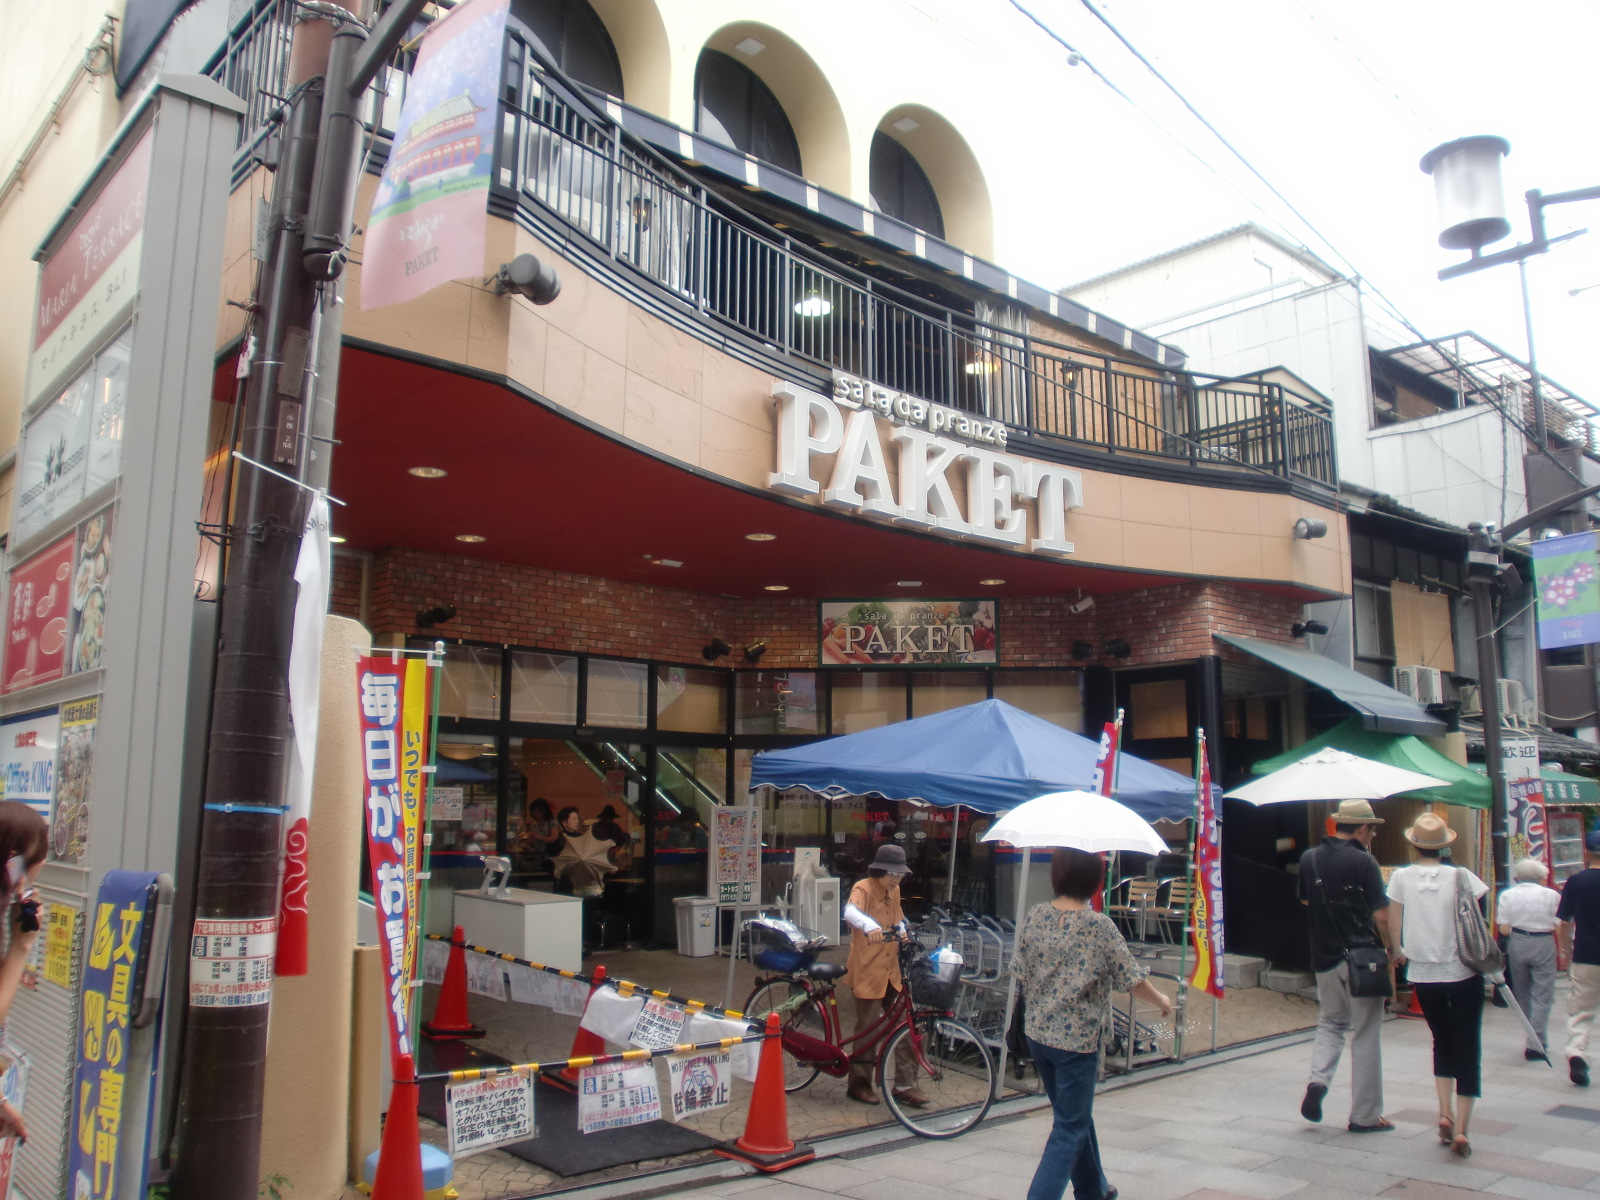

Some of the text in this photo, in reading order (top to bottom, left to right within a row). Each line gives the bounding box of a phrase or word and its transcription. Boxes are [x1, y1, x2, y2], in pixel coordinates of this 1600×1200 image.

[404, 245, 440, 277] PAKET
[833, 375, 1008, 447] sala da pranze
[768, 380, 1084, 555] PAKET
[864, 611, 888, 620] sala
[910, 611, 945, 621] pranze
[842, 624, 975, 654] PAKET
[1502, 745, 1537, 759] 歓迎
[7, 759, 53, 794] Office KING
[703, 1052, 730, 1065] PARKING
[673, 1082, 729, 1115] 駐輪禁止
